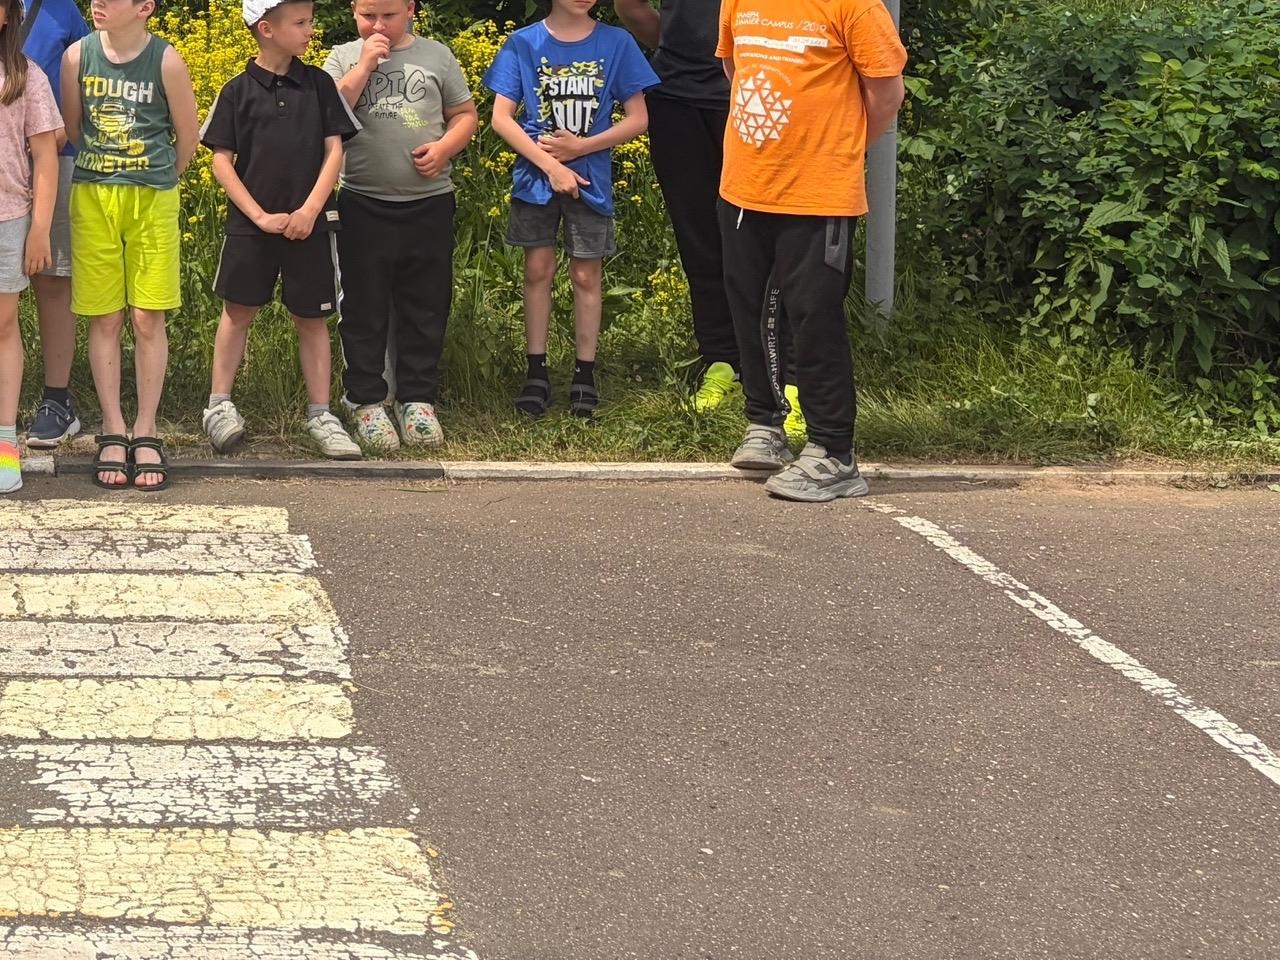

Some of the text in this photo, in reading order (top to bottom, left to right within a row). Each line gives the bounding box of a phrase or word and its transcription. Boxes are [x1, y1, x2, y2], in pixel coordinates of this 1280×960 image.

[761, 19, 794, 29] CAMPUS
[82, 76, 154, 104] TOUGH
[357, 69, 427, 107] PIC
[552, 99, 592, 133] OUT
